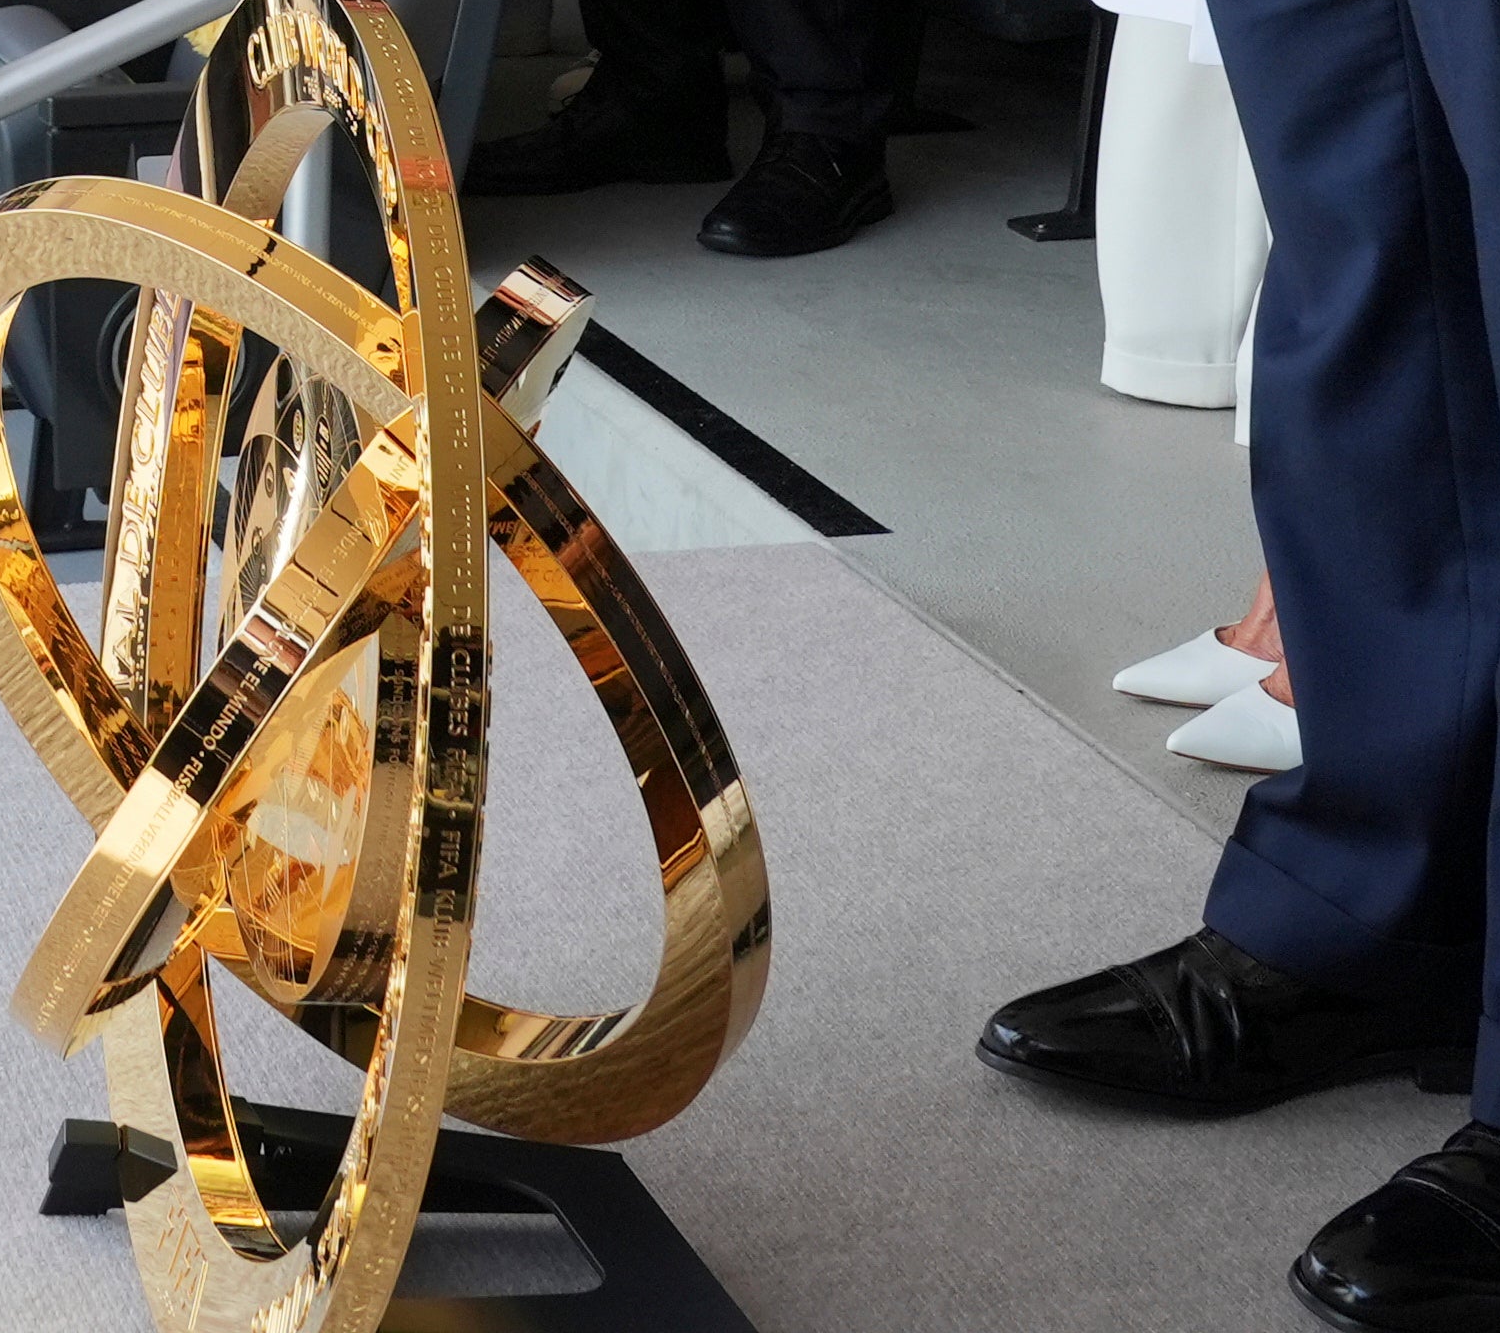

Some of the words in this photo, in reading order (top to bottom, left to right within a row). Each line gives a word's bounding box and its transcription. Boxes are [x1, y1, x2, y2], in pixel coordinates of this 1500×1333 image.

[247, 10, 299, 91] CLUB
[297, 10, 365, 121] WORLD
[239, 670, 261, 691] EL
[449, 648, 471, 737] CLUBES
[202, 688, 250, 751] MUNDO
[438, 829, 461, 879] FIFA
